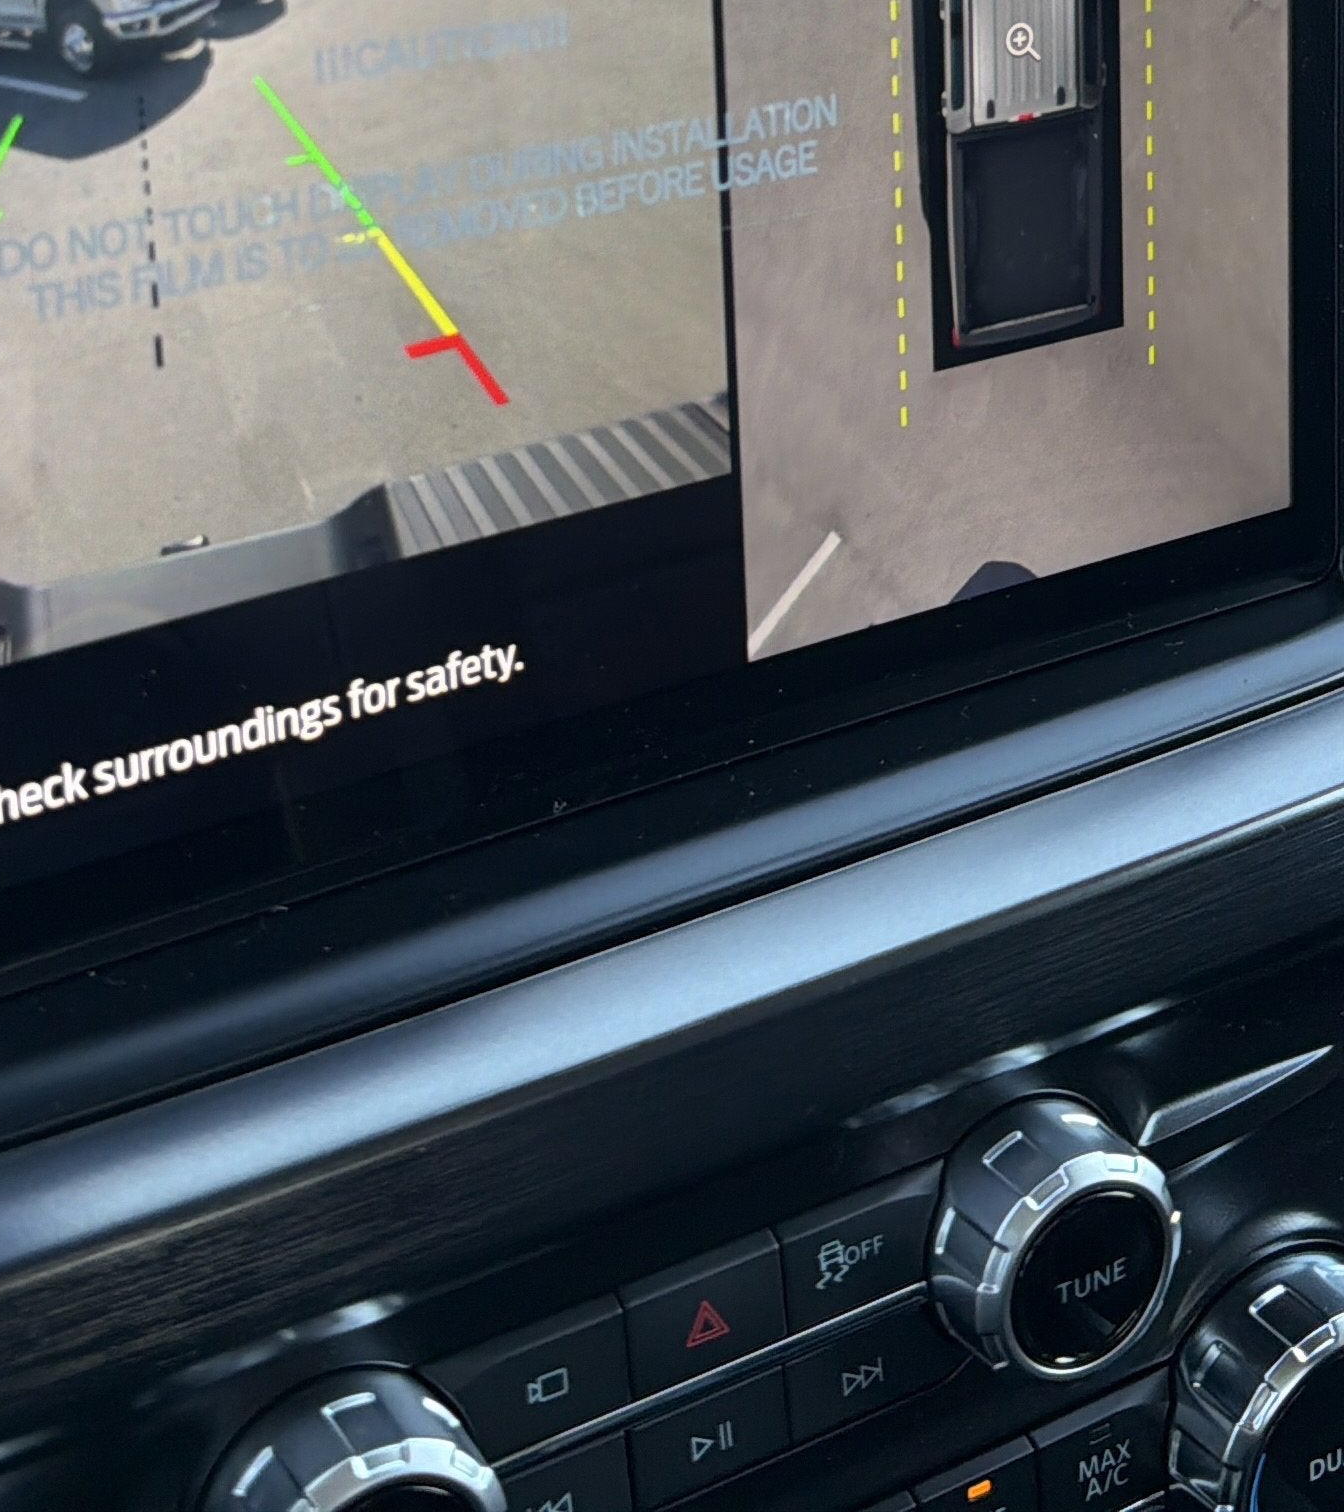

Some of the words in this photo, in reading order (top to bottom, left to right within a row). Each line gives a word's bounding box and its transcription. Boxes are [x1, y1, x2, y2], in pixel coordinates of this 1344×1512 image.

[67, 215, 154, 263] NOT
[159, 186, 299, 243] TOUCH
[308, 161, 461, 221] DSPLAY
[611, 92, 839, 168] INSTALLATION
[28, 270, 124, 324] THIS
[131, 248, 227, 304] FILM
[235, 239, 270, 283] IS
[279, 230, 331, 277] TO
[574, 159, 706, 220] BEFORE
[711, 138, 820, 194] USAGE
[91, 692, 342, 796] surroundings
[346, 676, 401, 720] for
[405, 642, 525, 704] safety.
[842, 1234, 884, 1266] OFF
[1055, 1256, 1128, 1304] TUNE
[1077, 1438, 1132, 1483] MAX
[1084, 1462, 1130, 1502] A/C
